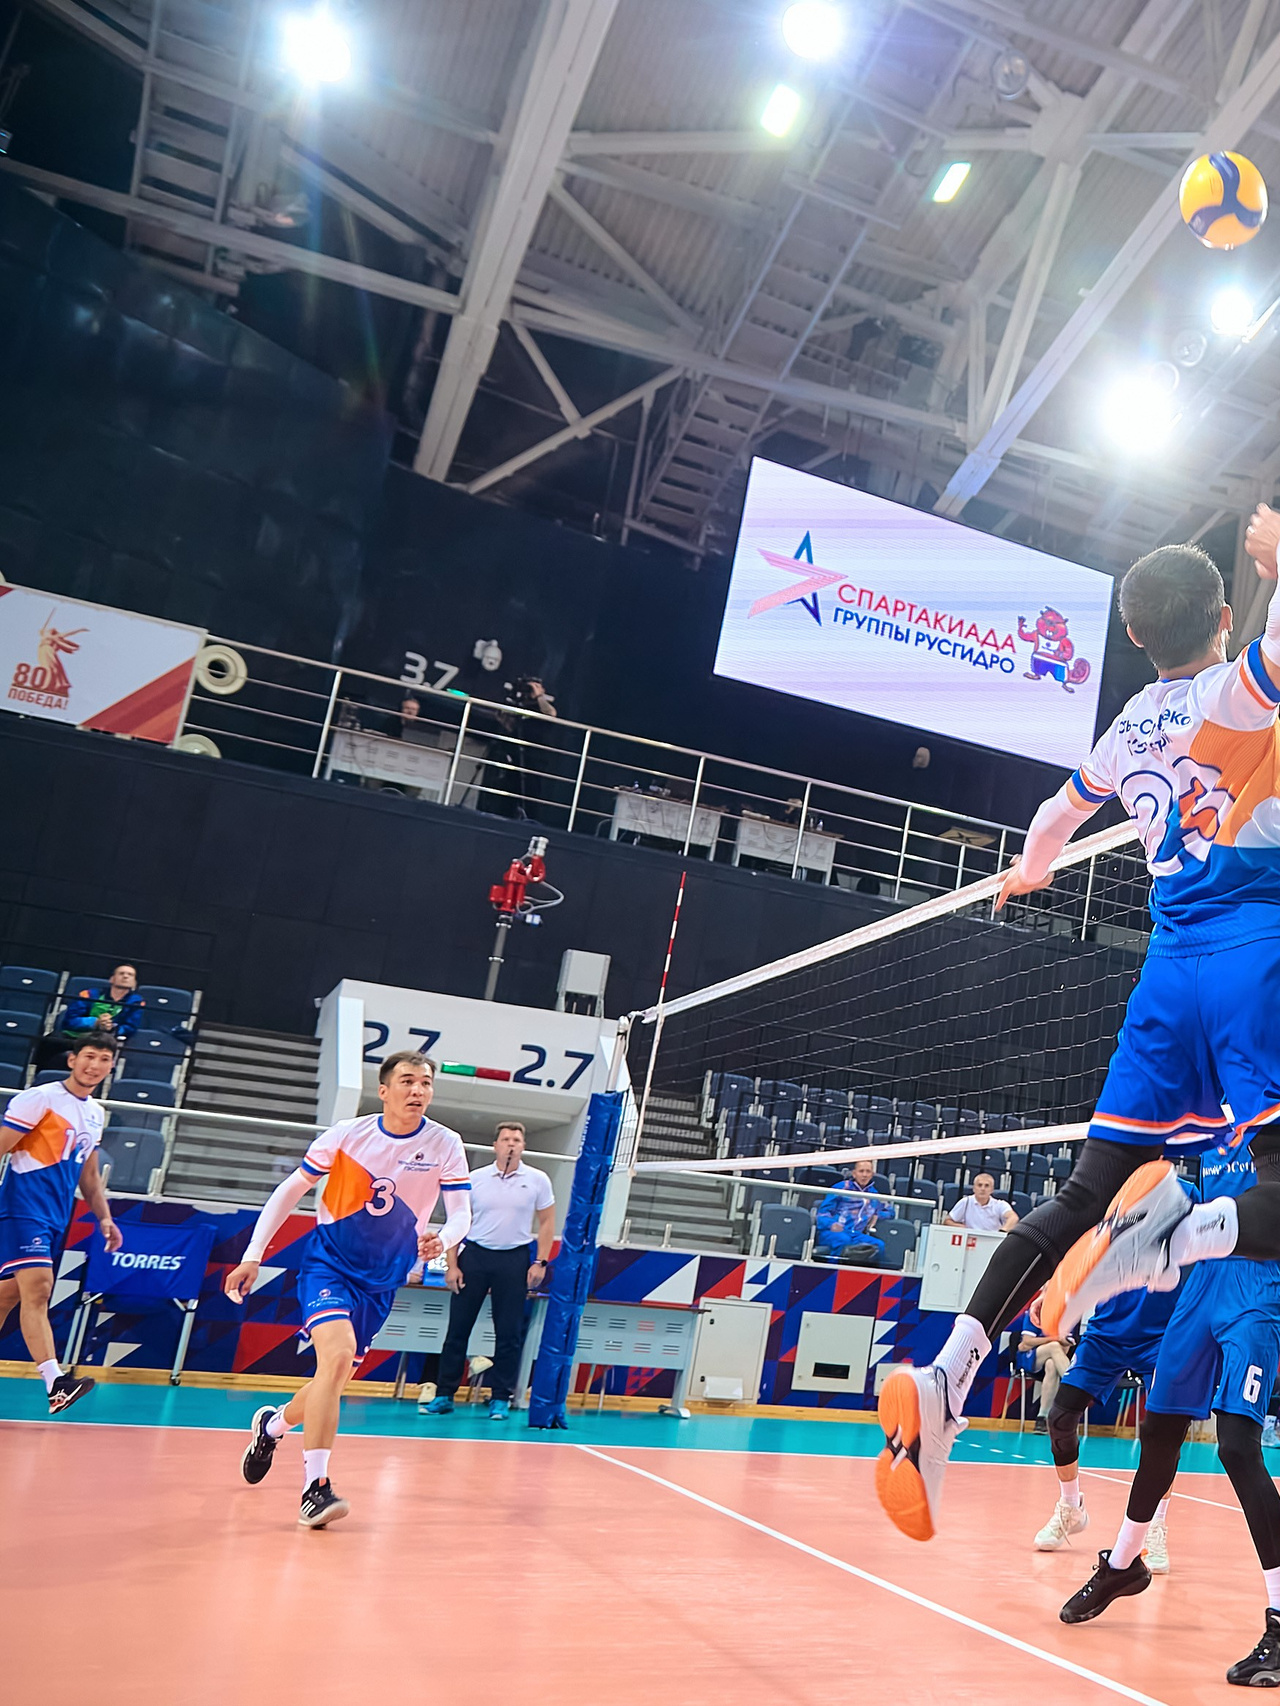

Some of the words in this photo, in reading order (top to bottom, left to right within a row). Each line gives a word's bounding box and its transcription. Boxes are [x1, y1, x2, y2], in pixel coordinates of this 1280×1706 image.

[837, 584, 1016, 654] СПАРТАКИАДА
[833, 607, 911, 644] ГРУППЫ
[914, 631, 1015, 674] РУСГИДРО
[12, 662, 48, 690] 80
[8, 687, 69, 710] ПОБЕДА!
[363, 1020, 441, 1064] 27
[513, 1044, 595, 1091] 2.7
[364, 1177, 396, 1218] 3
[112, 1251, 185, 1270] TORRES
[1243, 1364, 1263, 1404] 6
